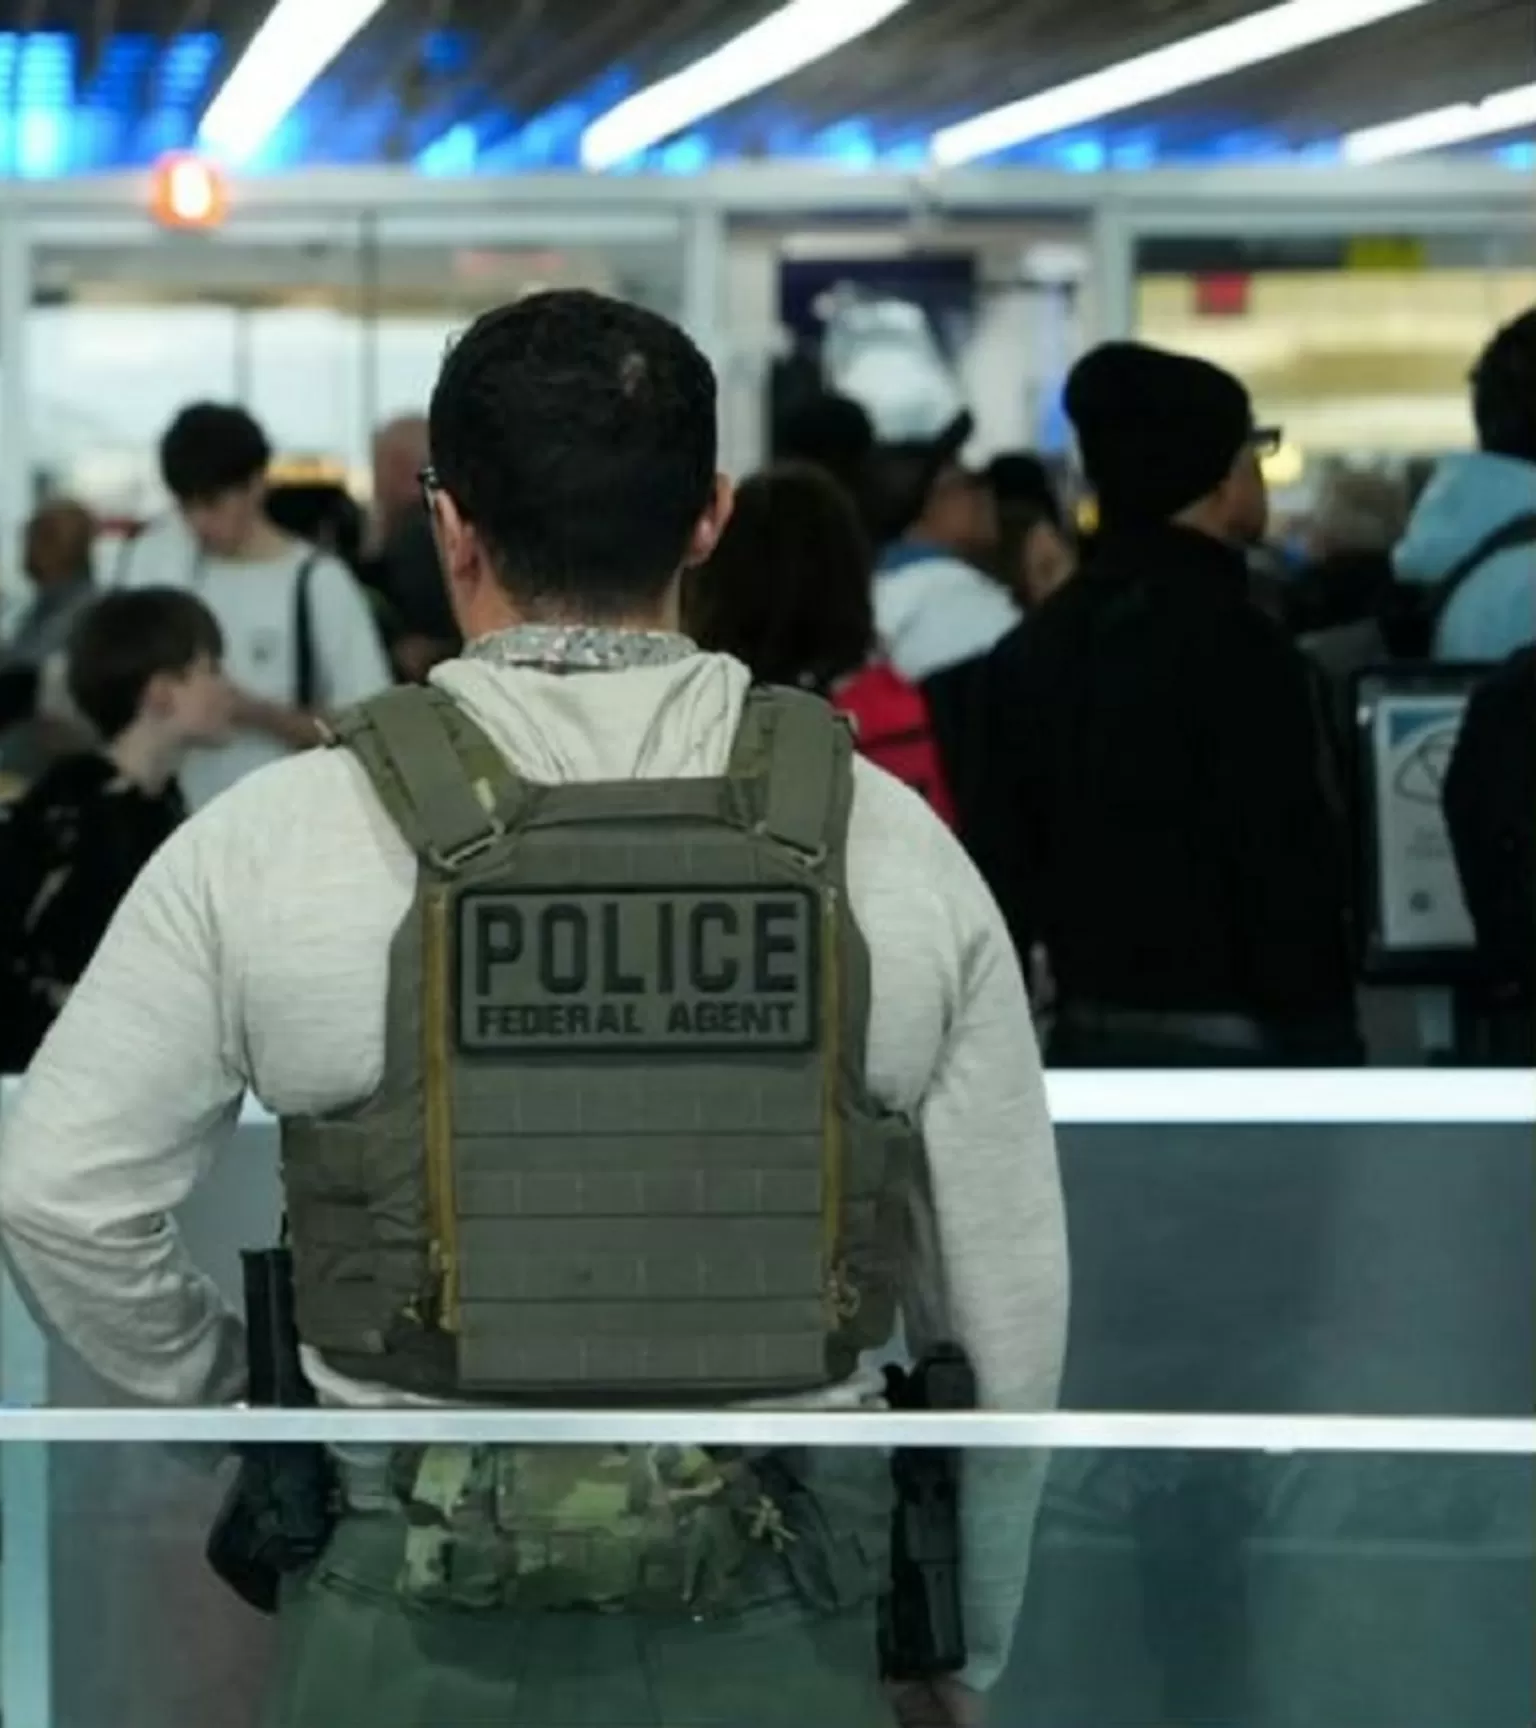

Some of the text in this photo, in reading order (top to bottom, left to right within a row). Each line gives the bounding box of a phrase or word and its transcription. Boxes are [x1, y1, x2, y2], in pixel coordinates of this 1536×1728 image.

[476, 901, 799, 996] POLICE
[477, 1001, 796, 1037] FEDERAL AGENT
